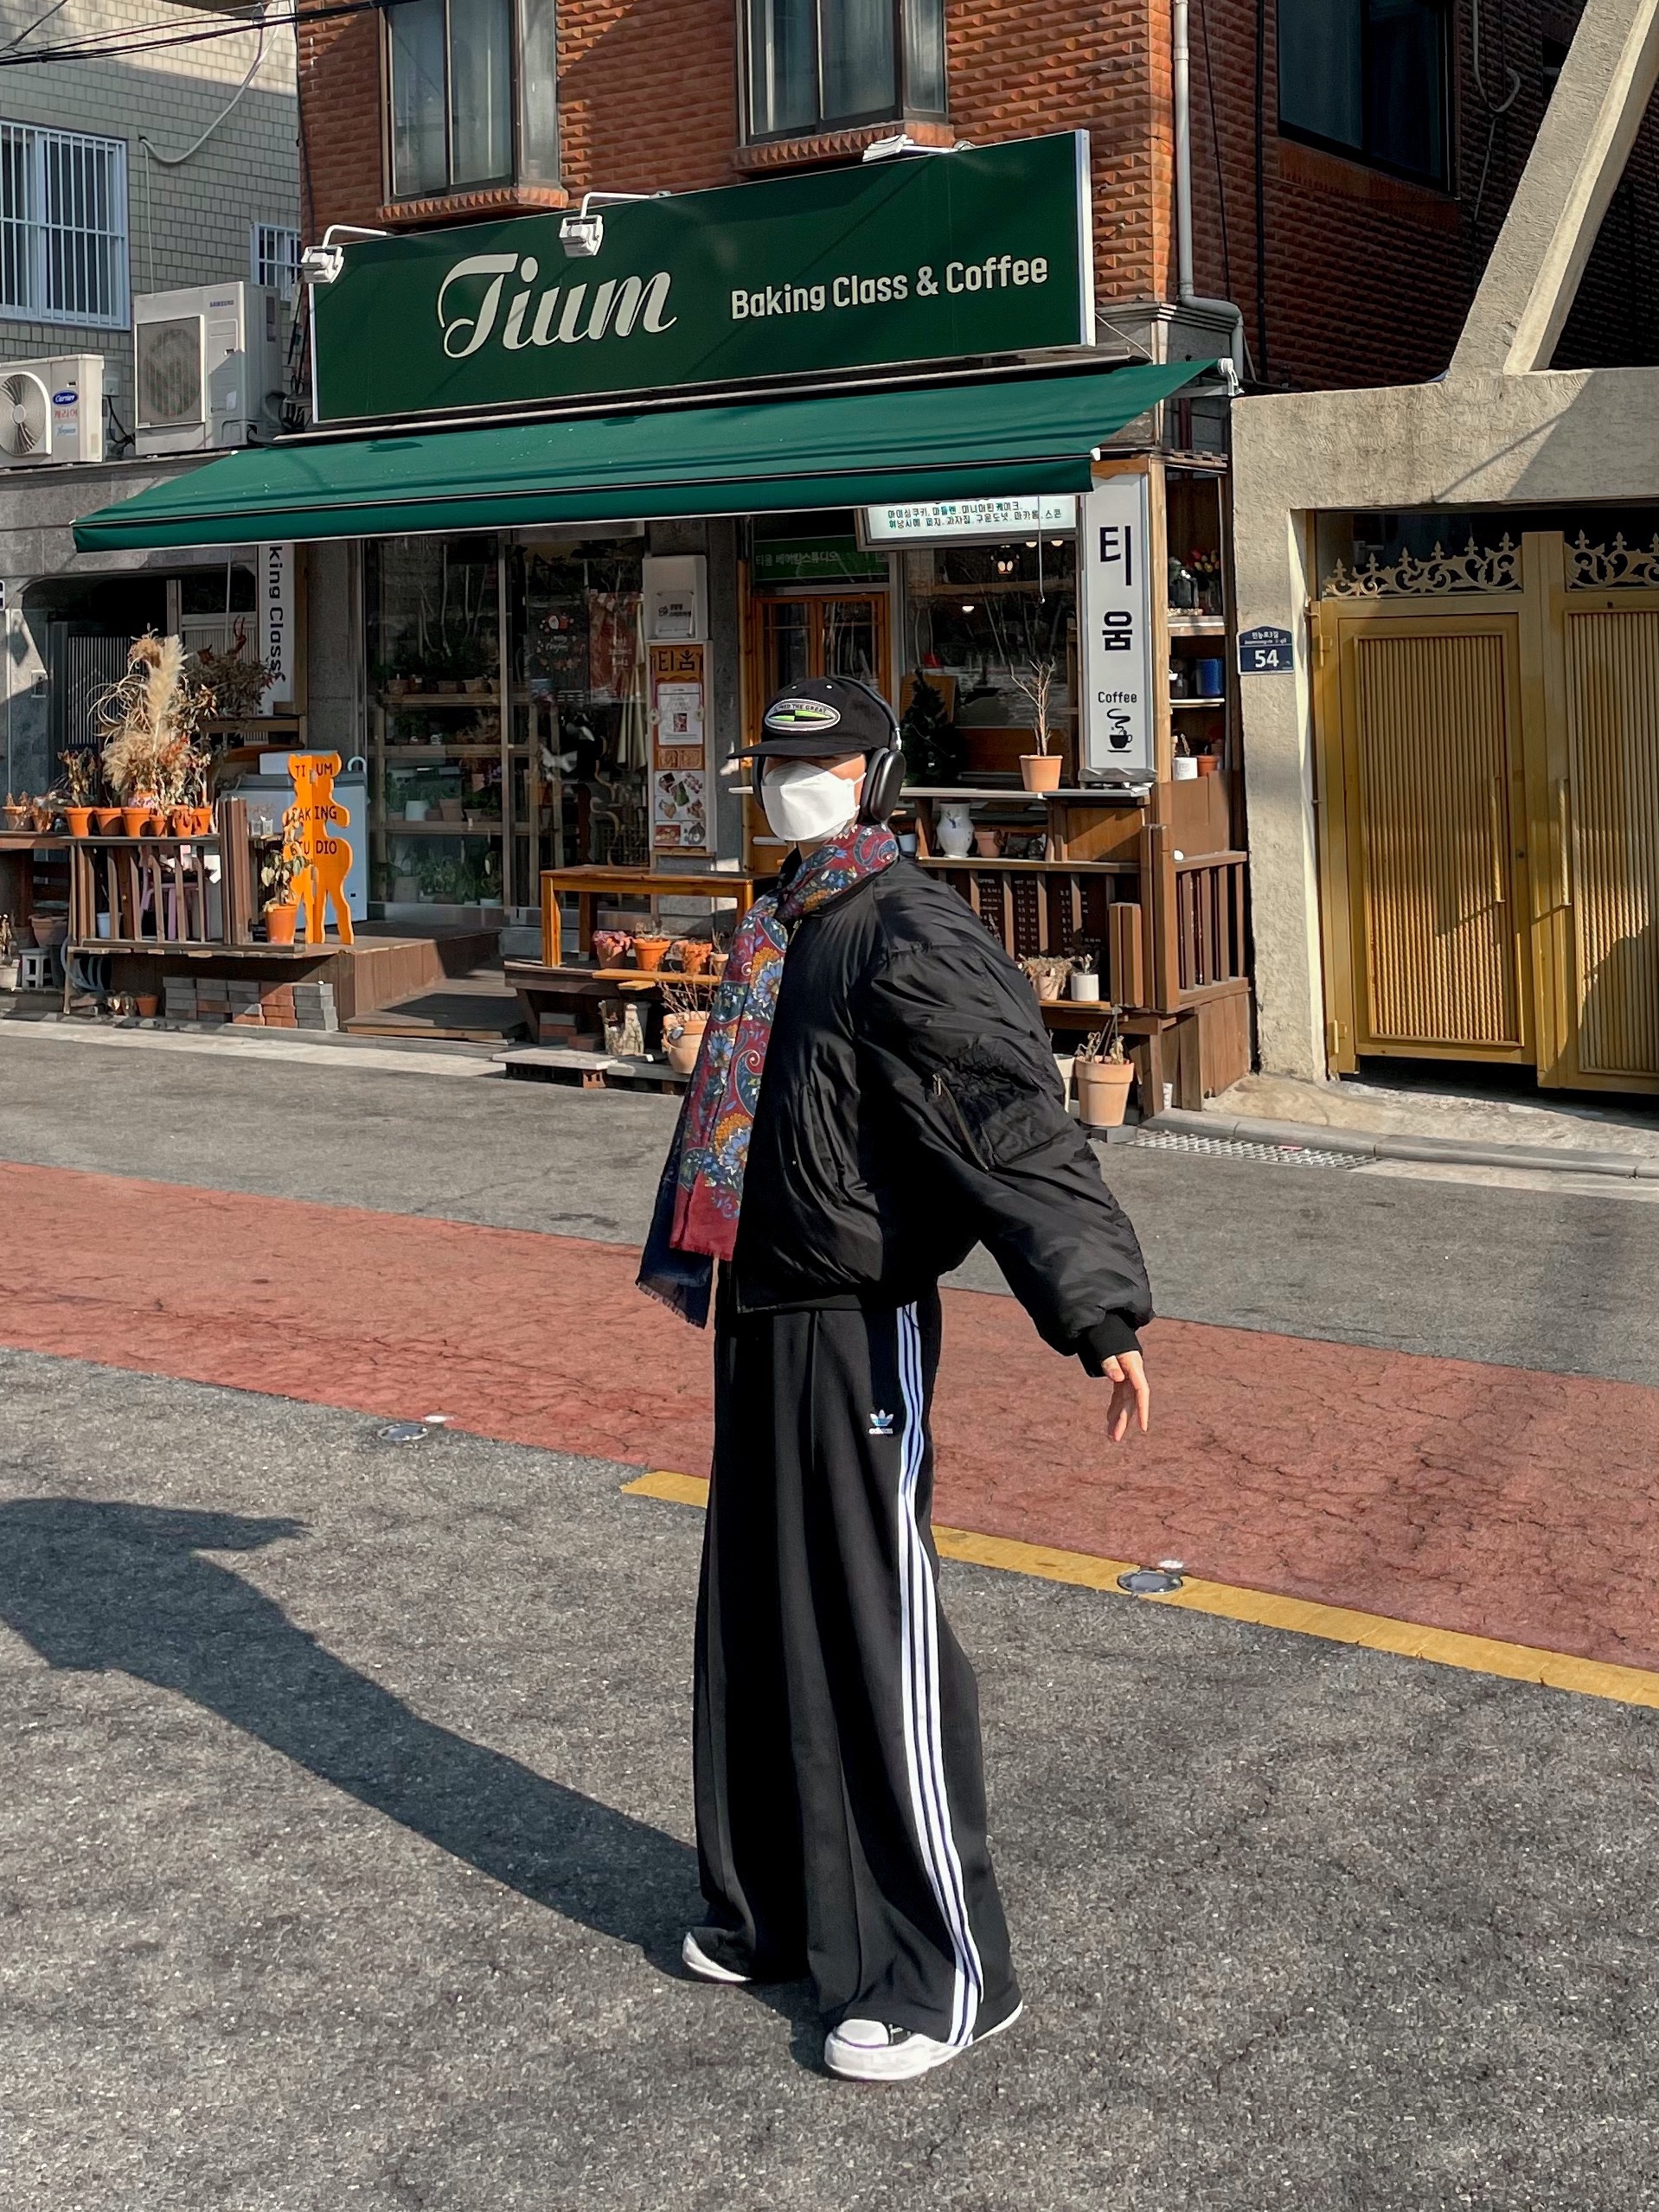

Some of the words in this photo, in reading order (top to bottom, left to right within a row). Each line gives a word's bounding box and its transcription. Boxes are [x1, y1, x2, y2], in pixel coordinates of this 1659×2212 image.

[438, 253, 677, 358] Tium
[732, 284, 825, 319] Baking
[832, 275, 908, 307] Class
[916, 265, 938, 297] &
[945, 255, 1047, 293] Coffee
[270, 607, 284, 670] Class
[1254, 649, 1279, 668] 54
[1098, 692, 1137, 704] Coffee
